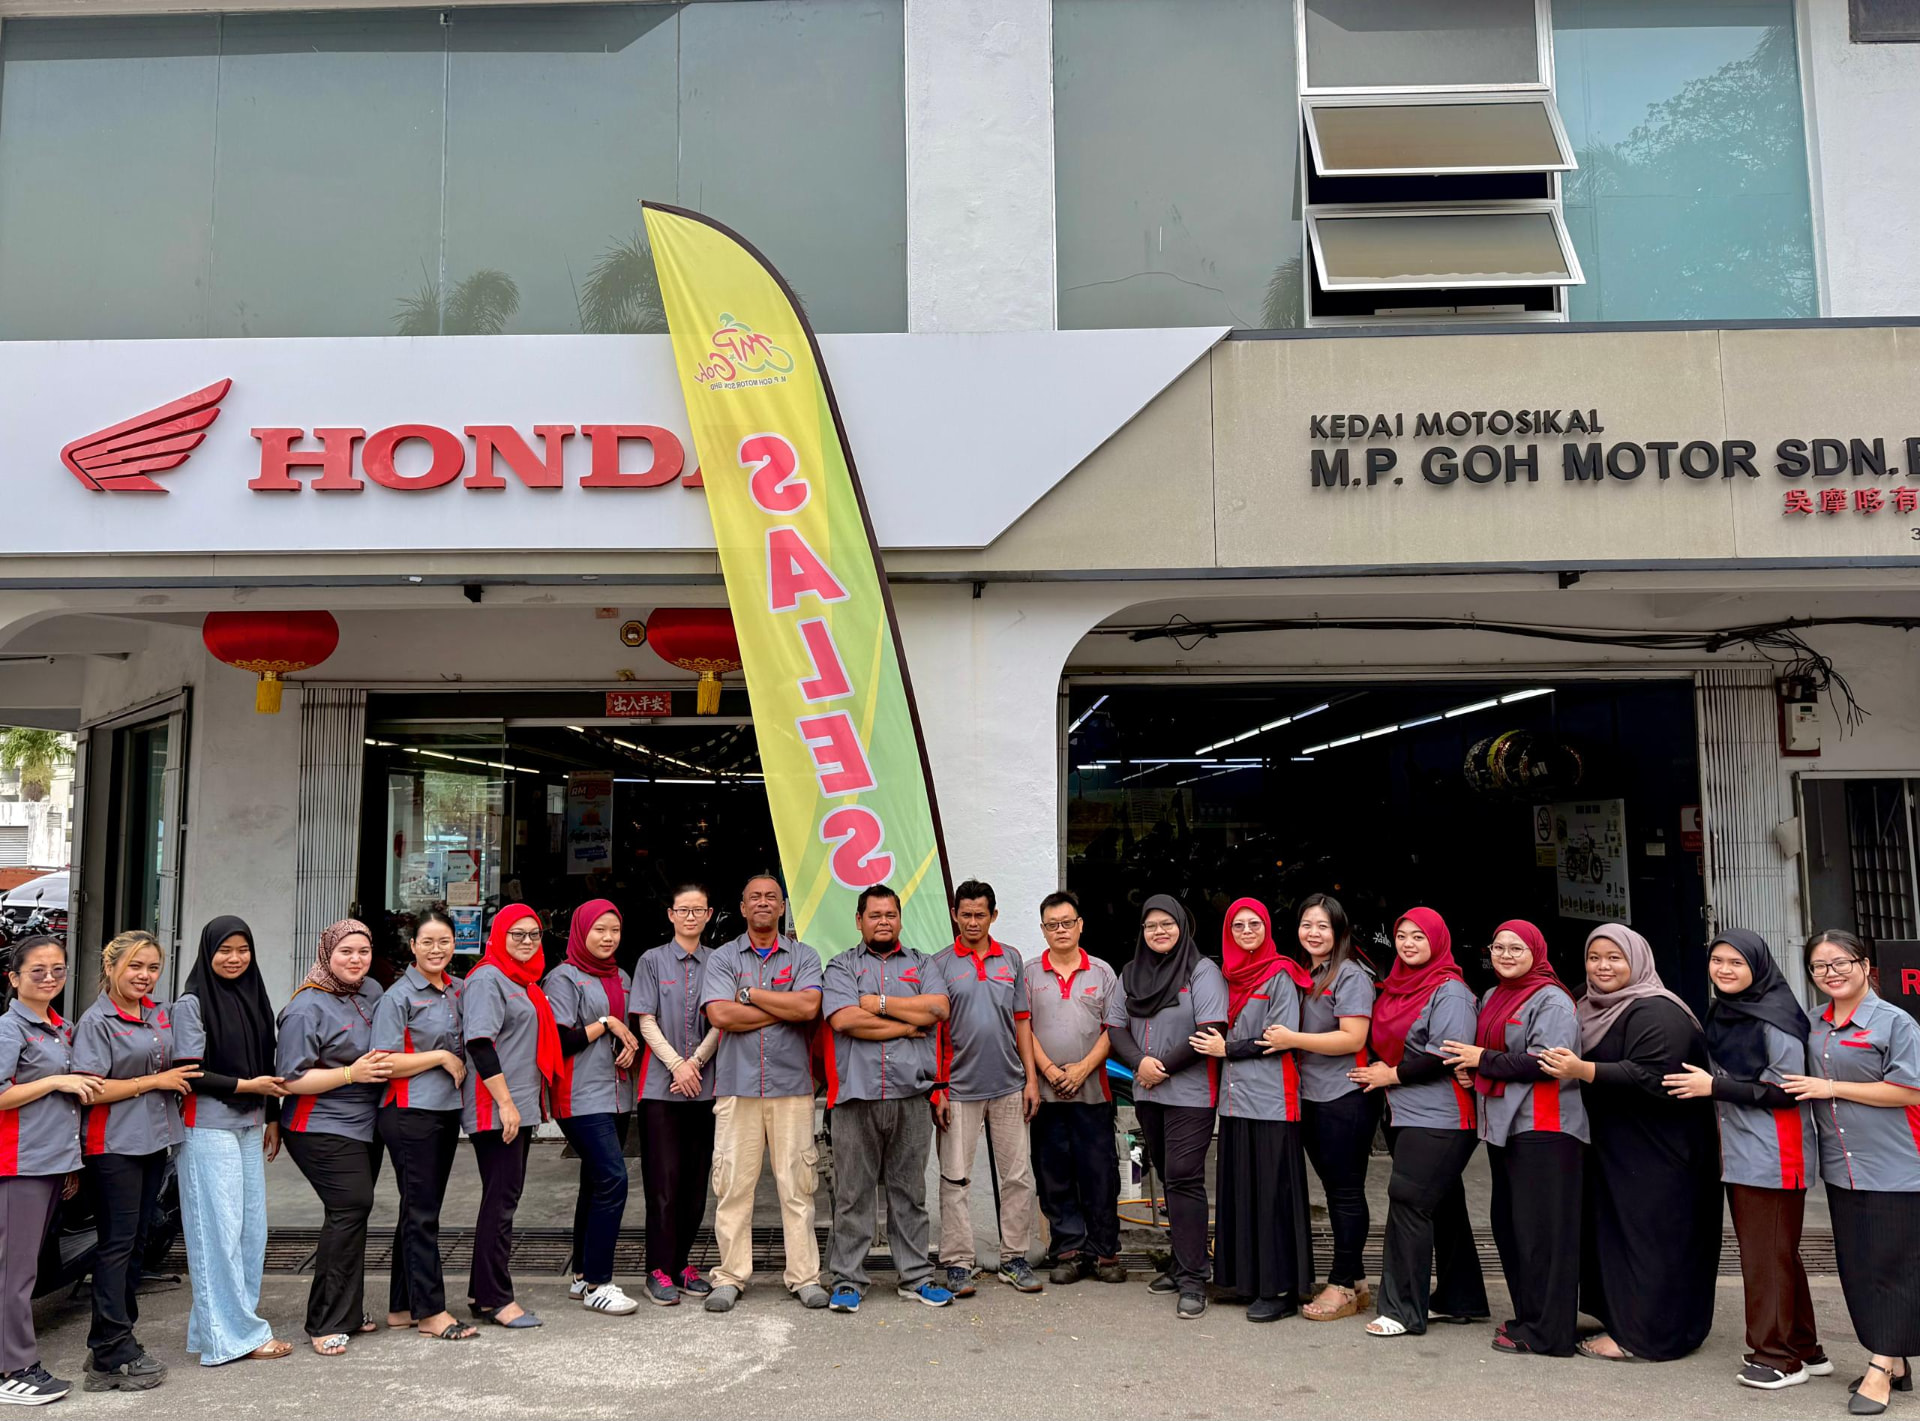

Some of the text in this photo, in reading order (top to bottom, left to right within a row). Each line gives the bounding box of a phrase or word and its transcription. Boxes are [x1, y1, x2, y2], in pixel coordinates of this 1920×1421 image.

[1310, 409, 1605, 439] KEDAI MOTOSIKAL
[248, 424, 704, 491] HOND
[1311, 448, 1404, 487] M.P.
[1420, 444, 1539, 485] GOH
[1562, 440, 1761, 482] MOTOR
[613, 695, 665, 712] 出入平安
